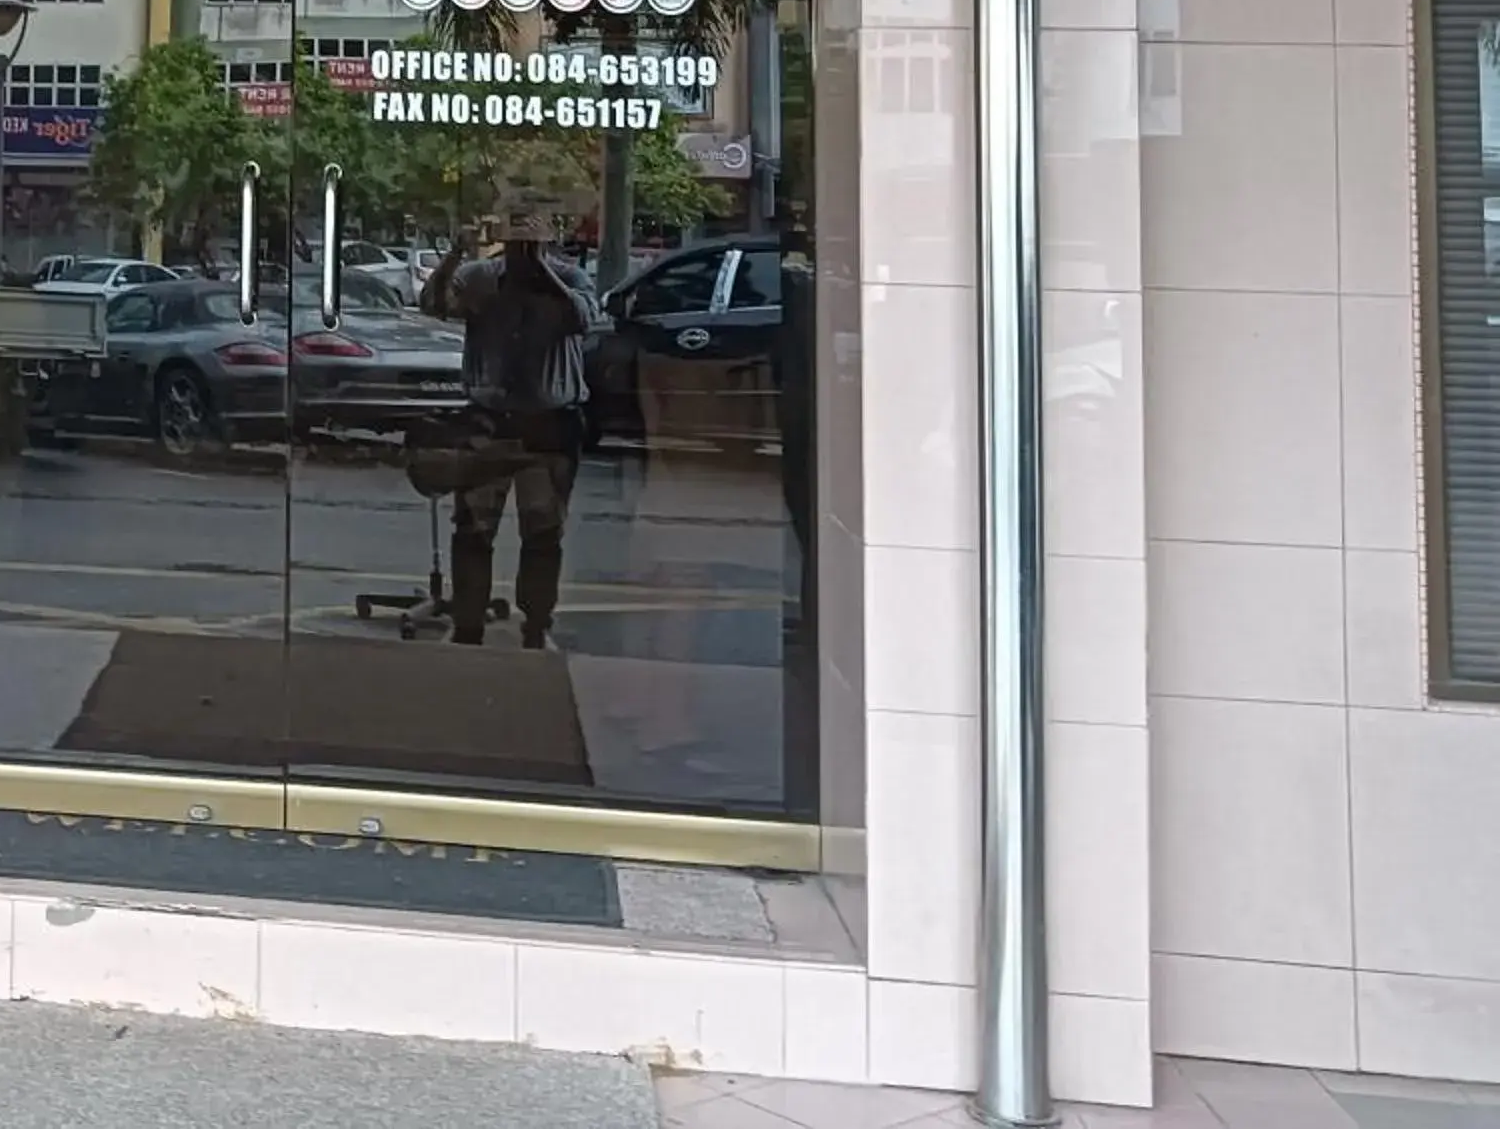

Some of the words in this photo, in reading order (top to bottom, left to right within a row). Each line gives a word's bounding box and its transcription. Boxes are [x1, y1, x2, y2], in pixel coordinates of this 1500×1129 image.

[370, 49, 467, 82] OFFICE
[474, 52, 523, 83] NO:
[528, 53, 717, 87] 084-653199
[373, 91, 425, 122] FAX
[431, 93, 480, 123] NO:
[485, 94, 662, 129] 084-651157
